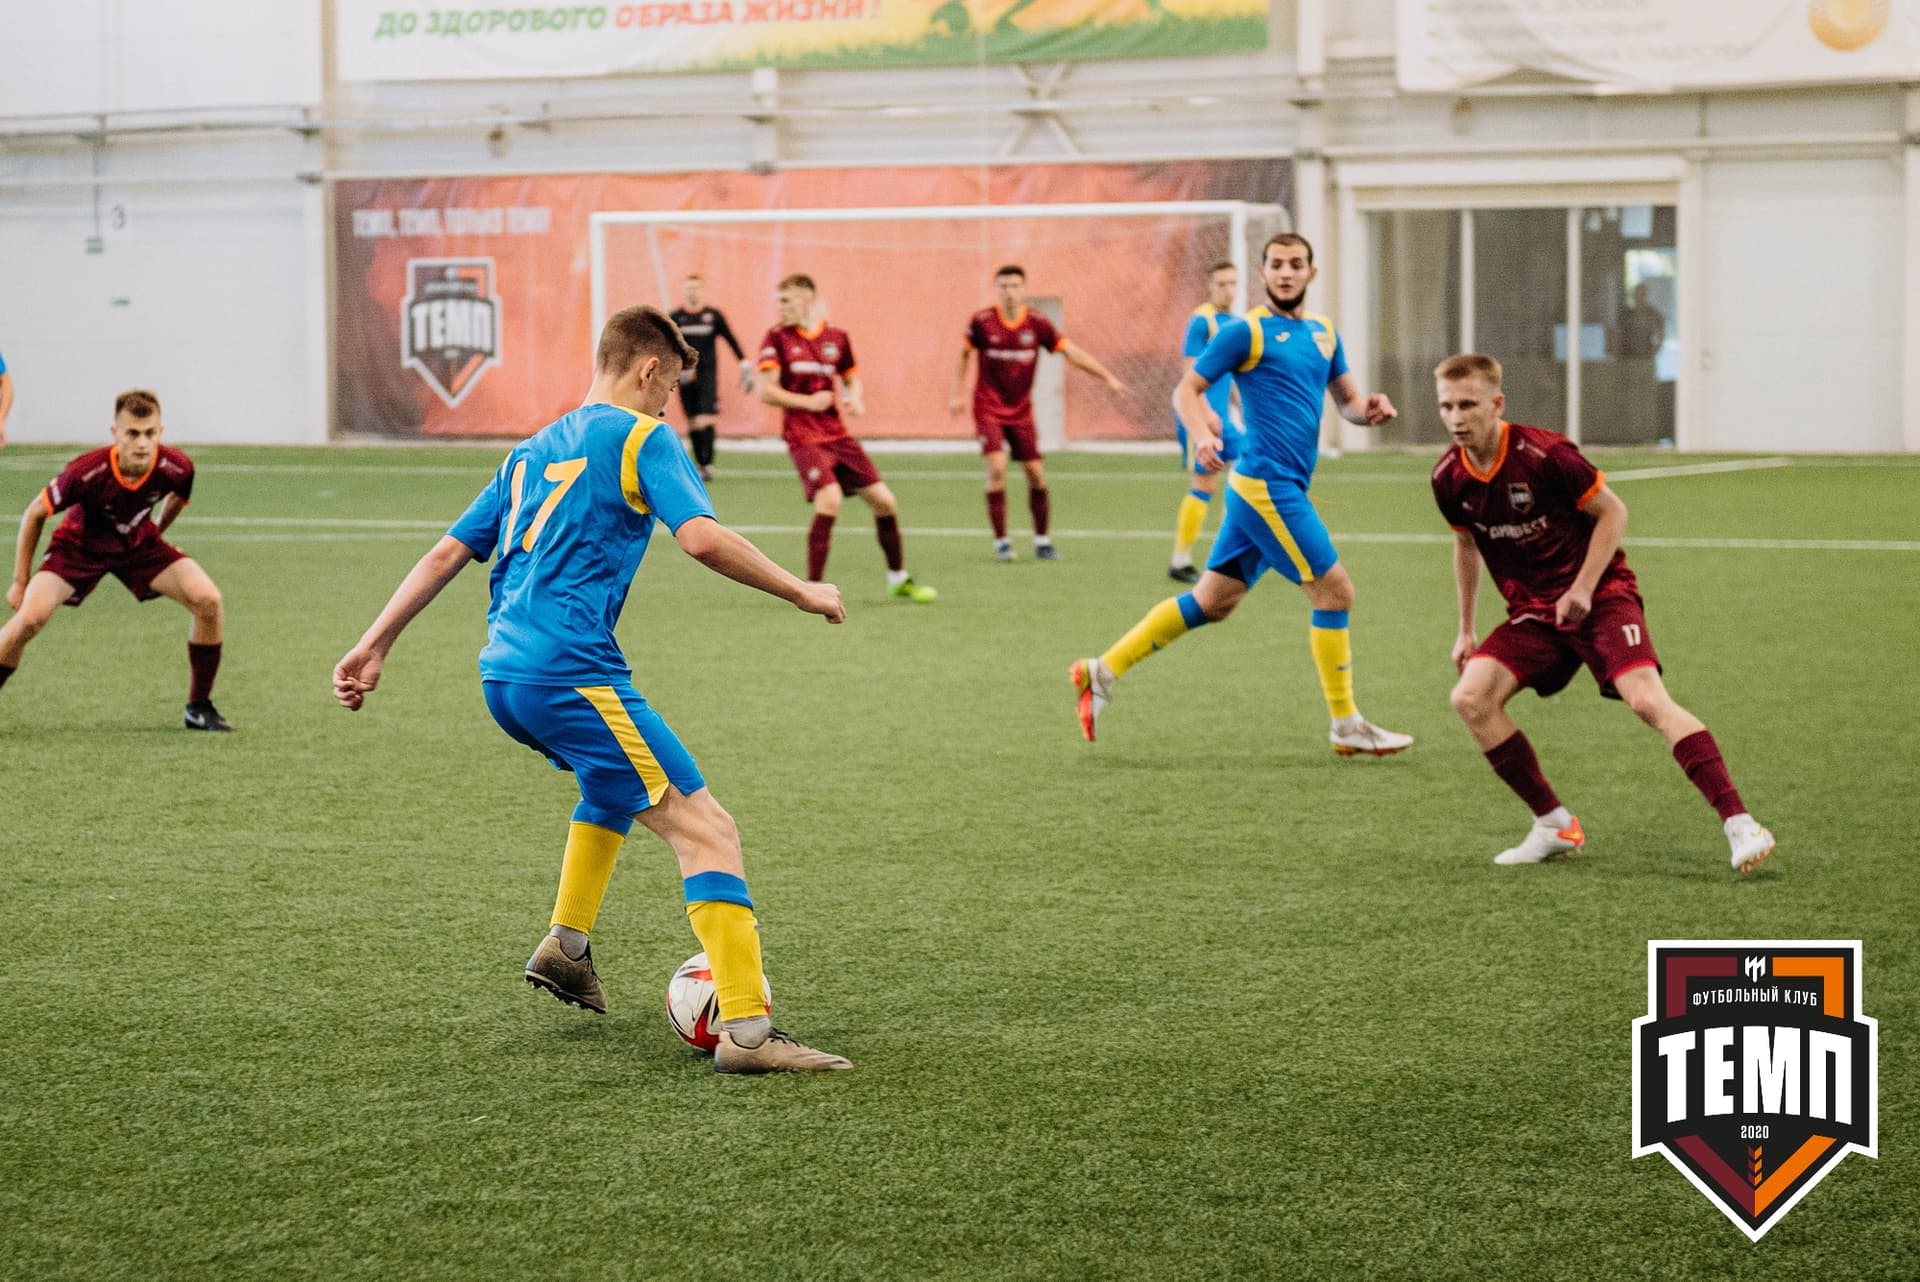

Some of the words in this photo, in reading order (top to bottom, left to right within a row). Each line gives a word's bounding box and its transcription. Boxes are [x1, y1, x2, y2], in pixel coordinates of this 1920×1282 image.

[374, 11, 418, 39] ДО
[424, 6, 608, 38] ЗДОРОВОГО
[614, 2, 734, 29] ОБРАЗА
[411, 299, 493, 352] ТЕМП
[503, 457, 587, 555] 17
[1621, 623, 1641, 647] 17
